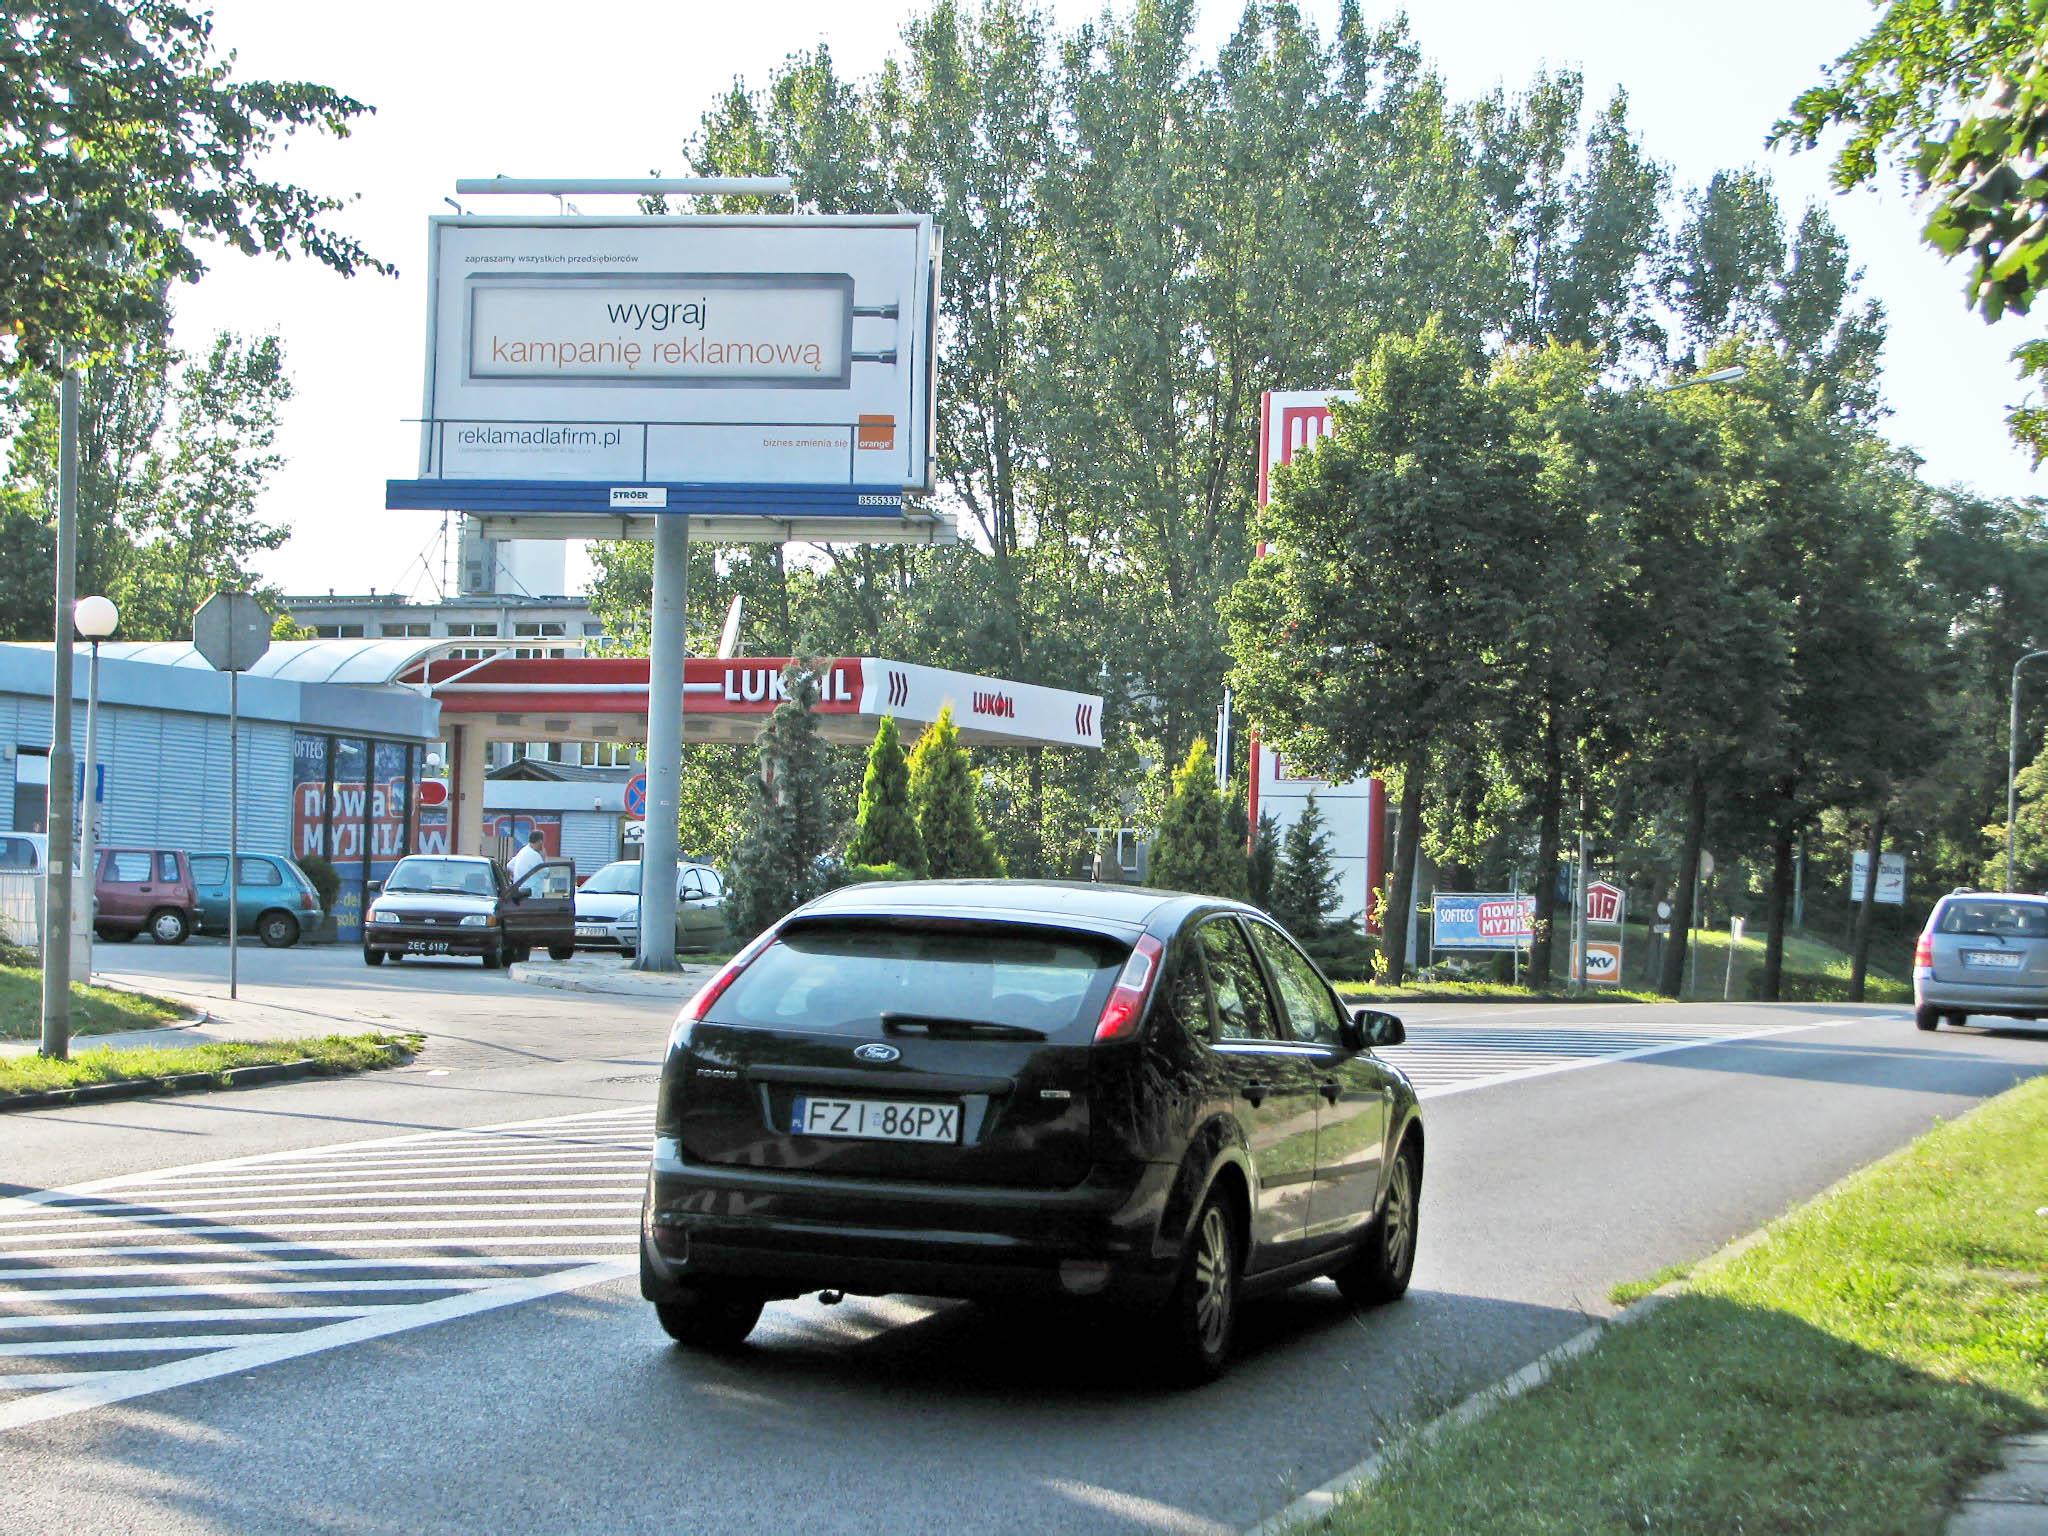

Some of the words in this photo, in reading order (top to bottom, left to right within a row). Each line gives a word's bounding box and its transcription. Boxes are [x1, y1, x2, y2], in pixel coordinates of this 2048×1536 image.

[464, 254, 516, 264] zapraszamy
[518, 254, 566, 264] wszystkich
[567, 254, 639, 265] przedsiębiorców
[607, 297, 707, 331] wygraj
[492, 336, 642, 370] kampanię
[653, 336, 822, 372] reklamową
[458, 427, 621, 449] reklamadlafirm.pl
[763, 439, 794, 447] biznes
[796, 439, 832, 448] zmienia
[859, 440, 890, 450] orange
[860, 496, 900, 505] 8555337
[724, 668, 853, 702] LUKIL
[973, 691, 1016, 719] LUKOIL
[304, 788, 386, 817] nowa
[1440, 908, 1475, 923] SOFTECS
[408, 941, 426, 951] ZEC
[429, 942, 449, 952] 6187
[696, 1068, 738, 1079] FOCUS
[809, 1101, 865, 1133] FZI
[882, 1105, 954, 1138] 86PX
